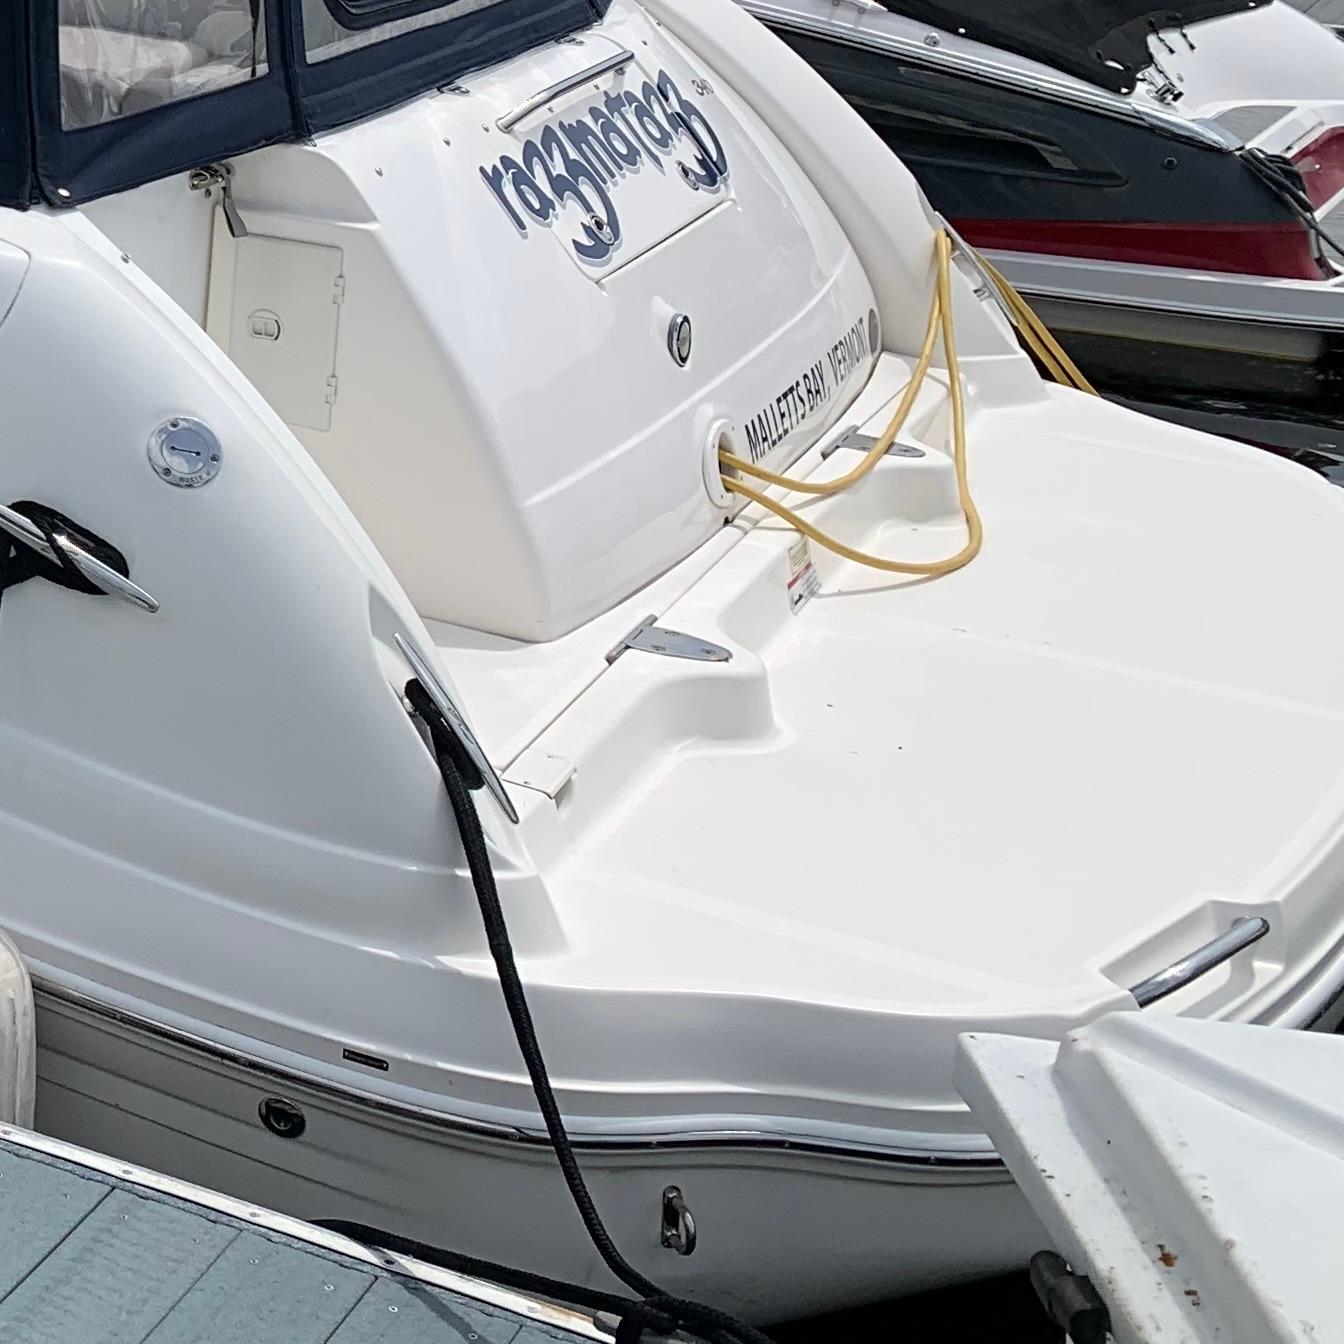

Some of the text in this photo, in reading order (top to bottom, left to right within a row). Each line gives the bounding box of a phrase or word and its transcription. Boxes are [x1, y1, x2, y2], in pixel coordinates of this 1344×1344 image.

[745, 317, 868, 464] MALLETTS BAY, VERMONT
